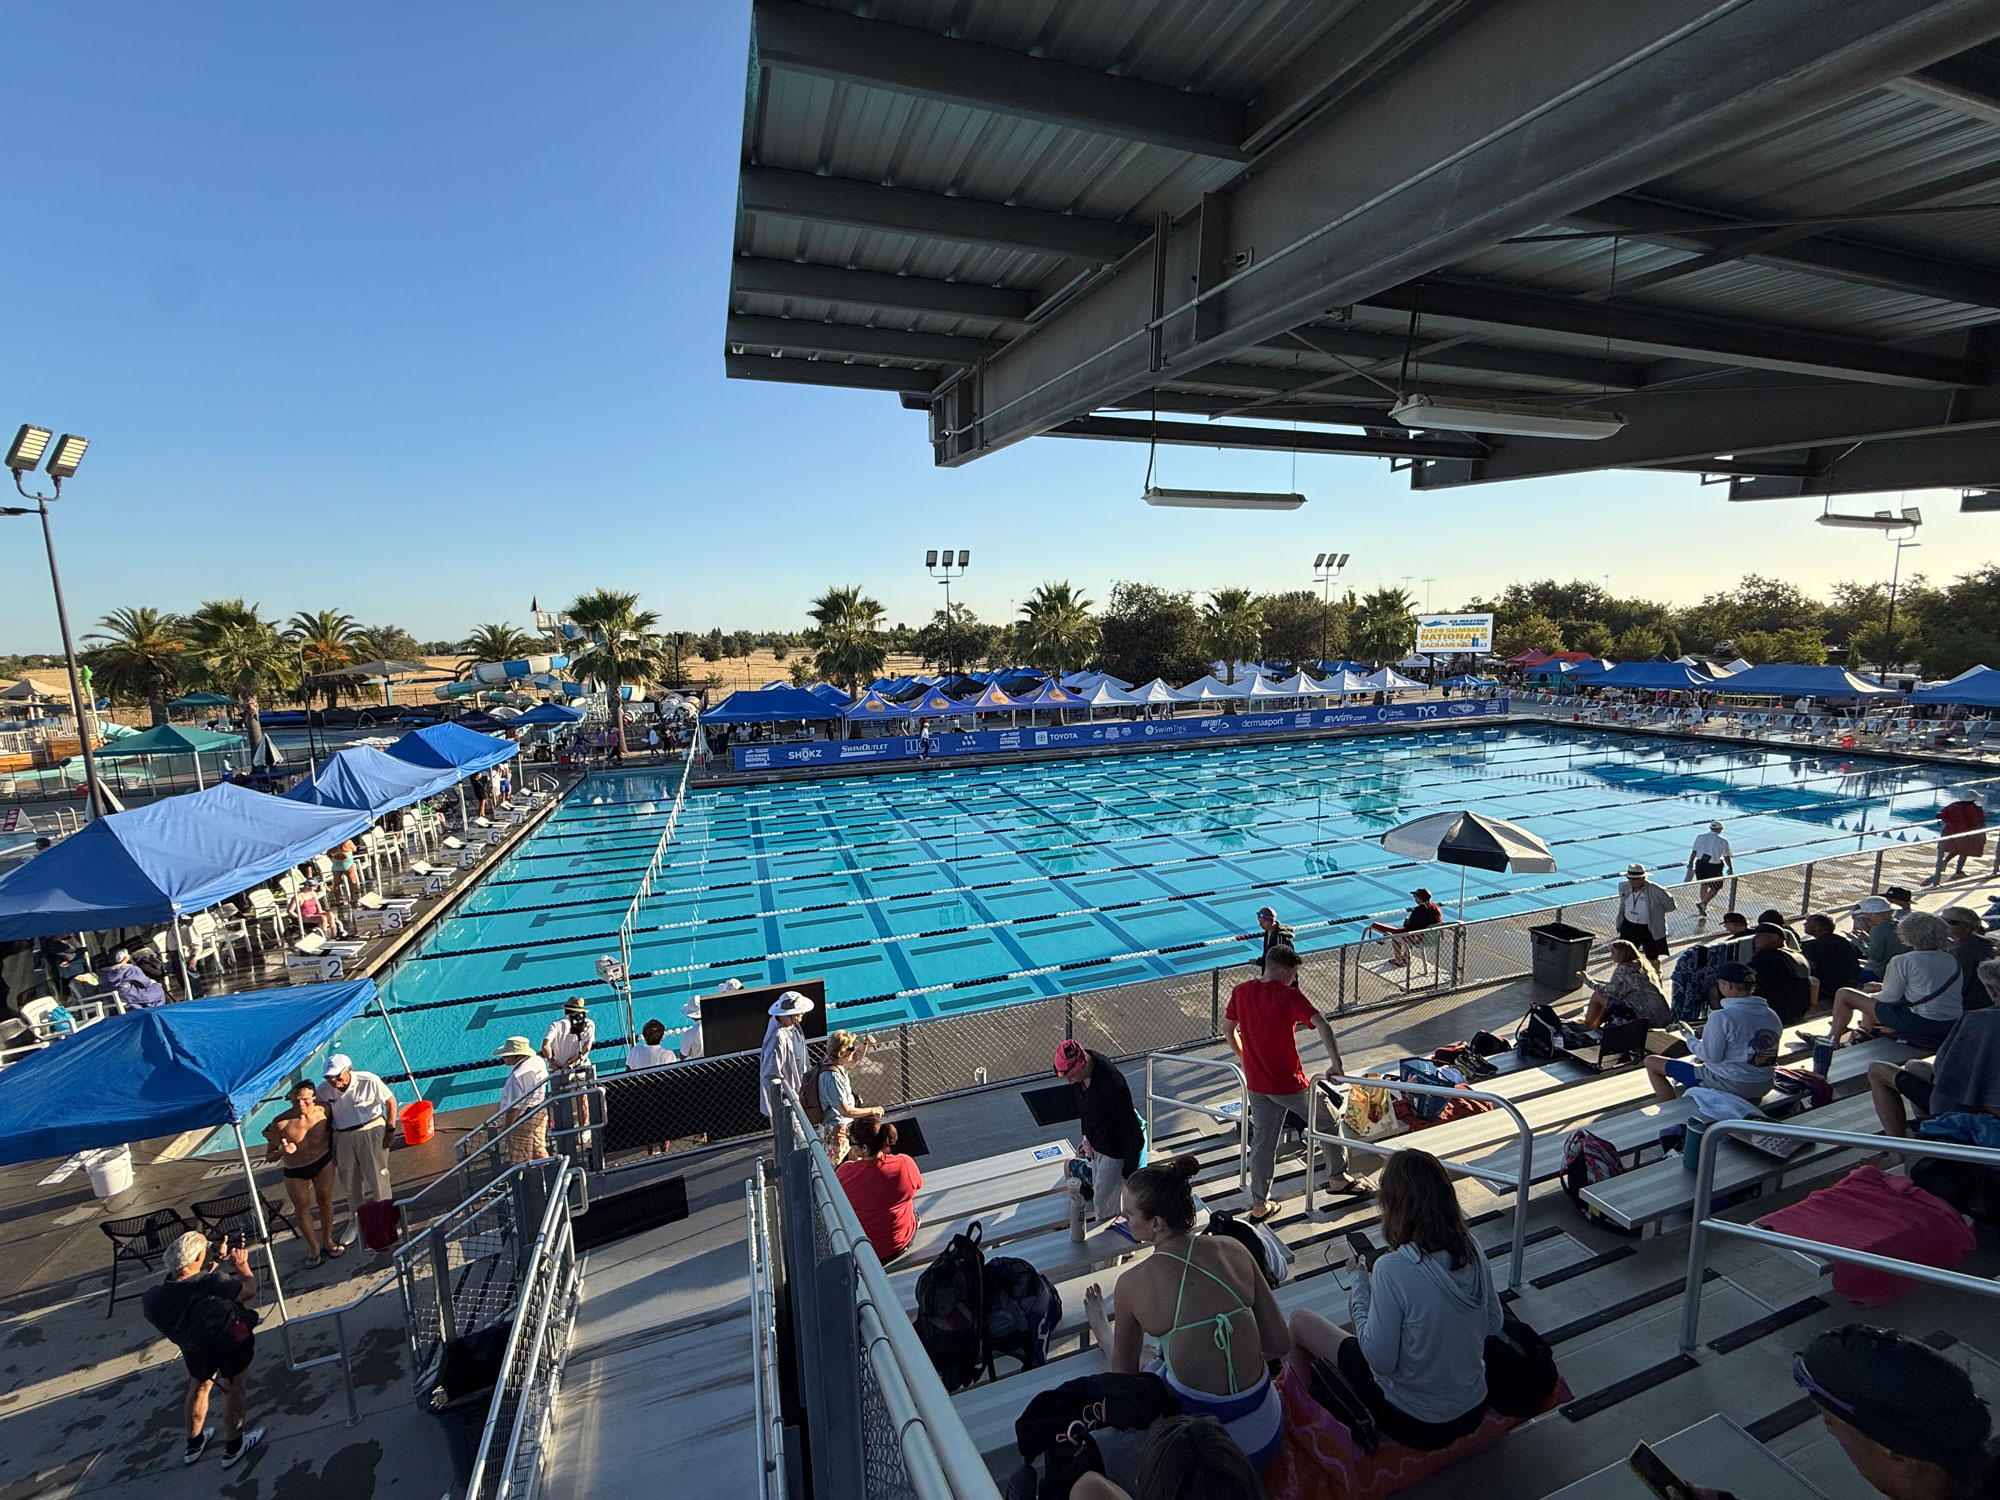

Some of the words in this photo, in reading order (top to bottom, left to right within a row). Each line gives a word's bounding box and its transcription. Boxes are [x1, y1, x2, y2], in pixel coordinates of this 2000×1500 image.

[1416, 706, 1437, 717] TYR
[1242, 717, 1284, 728] dermasport
[1154, 724, 1187, 734] SwimTrek
[788, 748, 822, 760] SHOKZ
[530, 798, 538, 808] 8
[513, 813, 521, 823] 7
[491, 832, 500, 842] 6
[465, 853, 475, 865] 5
[430, 878, 441, 892] 4
[388, 913, 401, 928] 3
[328, 960, 342, 978] 2
